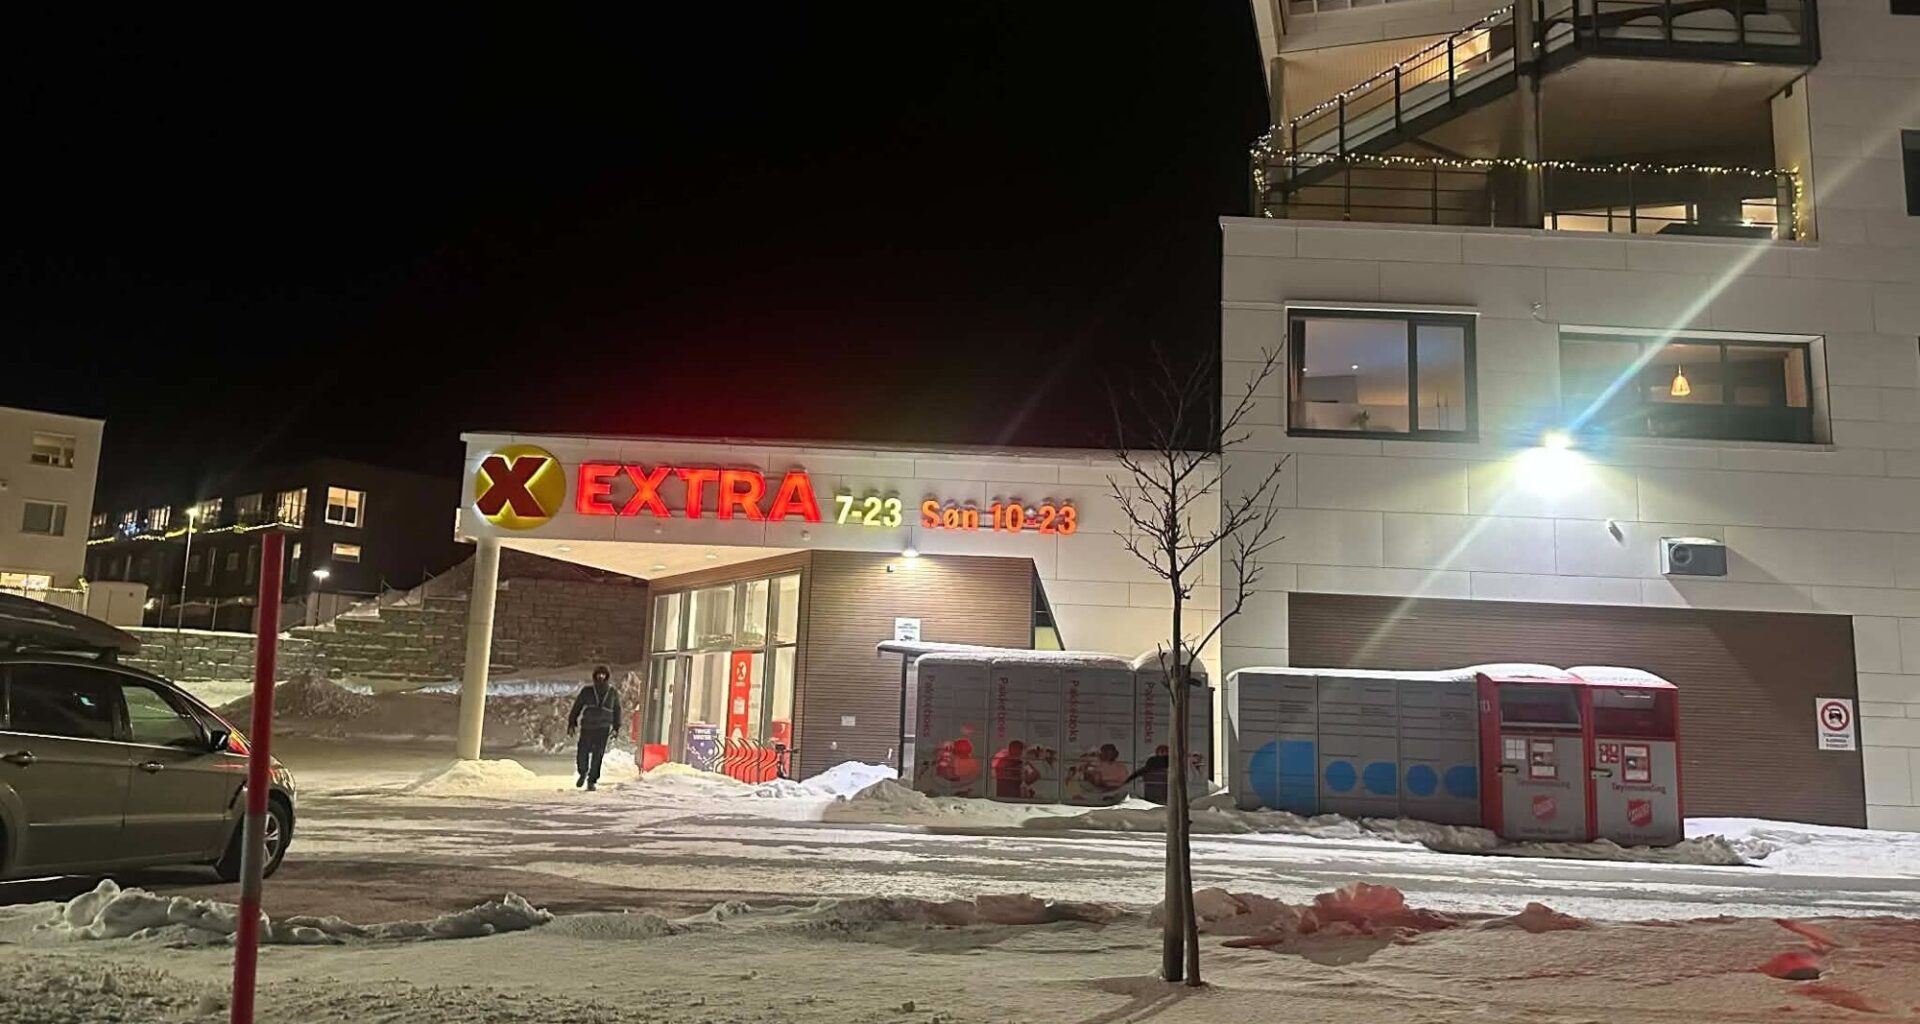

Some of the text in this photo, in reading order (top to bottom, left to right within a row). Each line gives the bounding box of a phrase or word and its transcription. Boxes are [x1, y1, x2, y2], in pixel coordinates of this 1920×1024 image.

[576, 462, 823, 524] EXTRA
[835, 495, 902, 528] 7-23
[920, 500, 1077, 536] Søn 10-23
